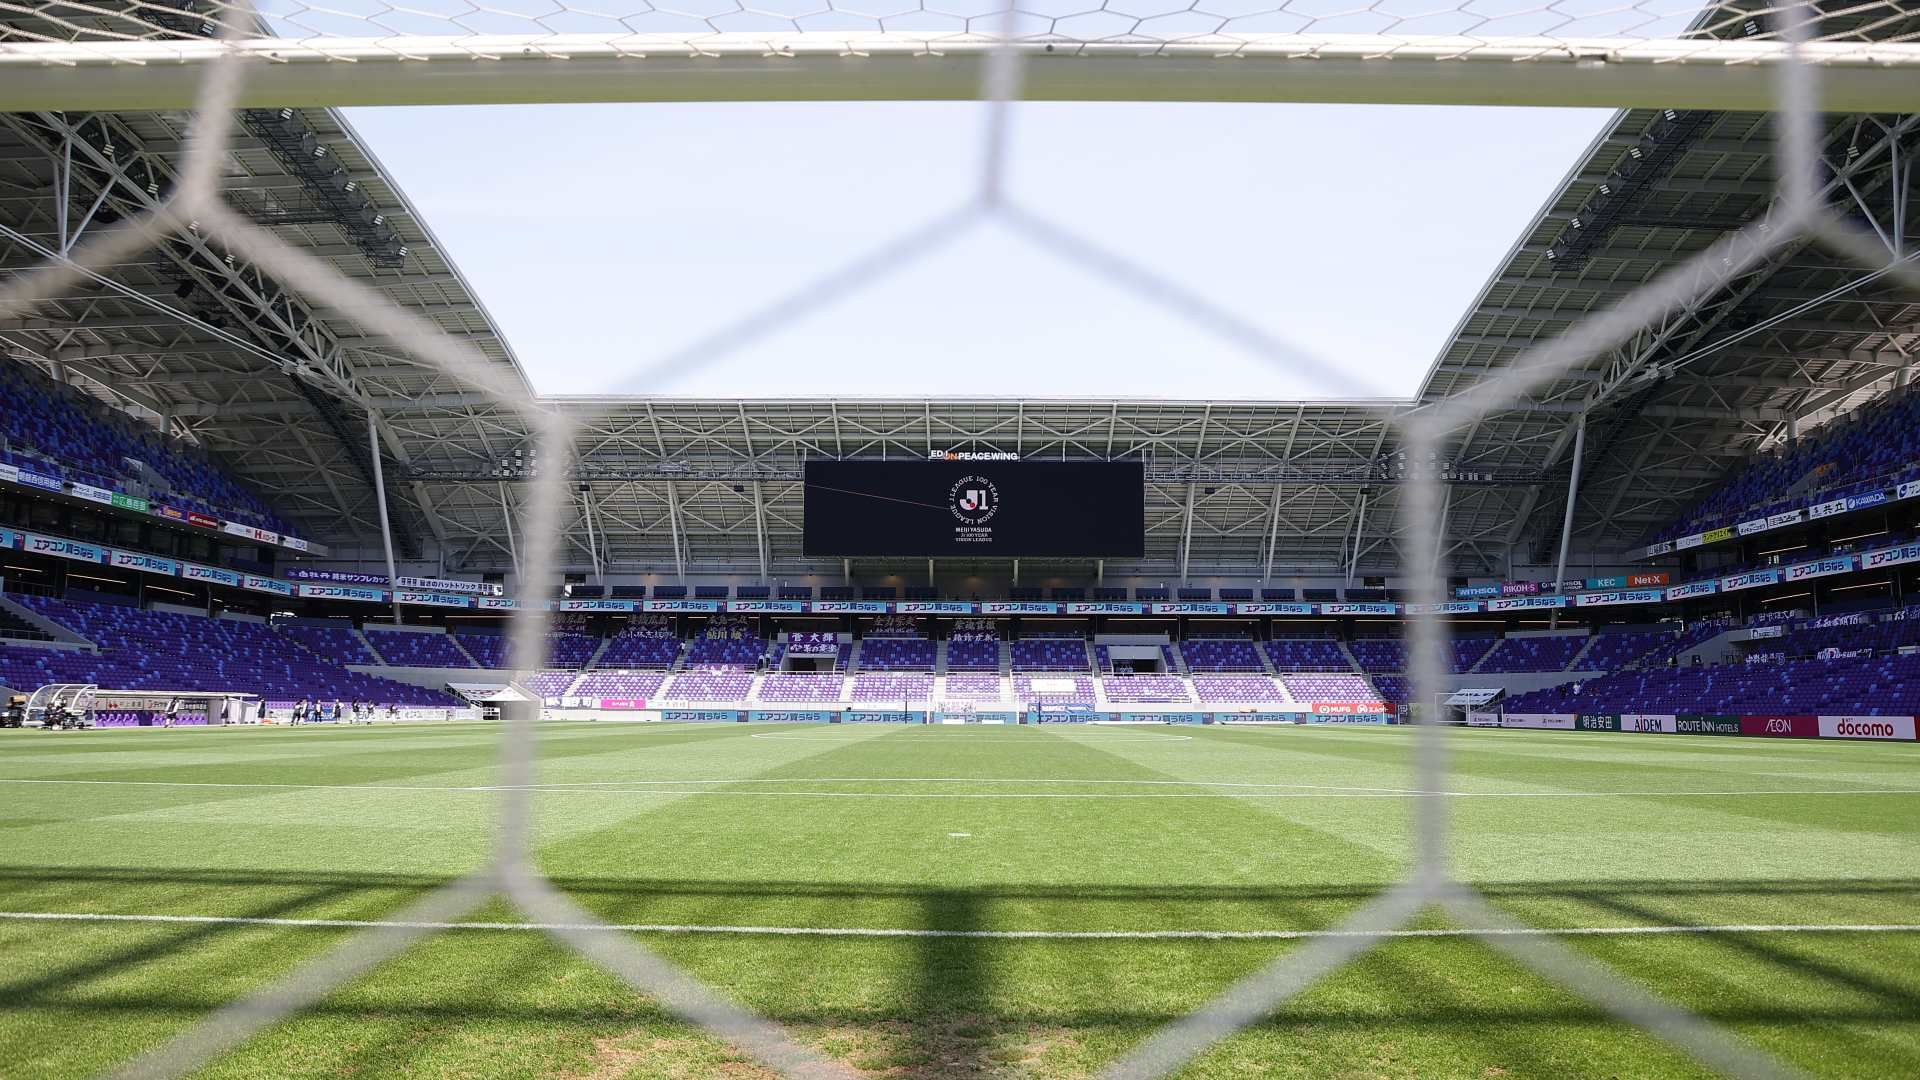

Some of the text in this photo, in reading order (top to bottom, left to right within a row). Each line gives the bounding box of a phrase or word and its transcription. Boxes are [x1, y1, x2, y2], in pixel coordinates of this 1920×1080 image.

[958, 452, 1018, 460] PEACEWING
[988, 481, 999, 502] YEAR
[1855, 492, 1885, 505] KAWADA
[1823, 502, 1845, 515] 共立
[1598, 579, 1615, 587] KEC
[1460, 587, 1499, 596] WITHSOL
[1582, 715, 1613, 729] 明治安田
[1678, 720, 1700, 731] ROUTE
[1715, 724, 1739, 733] HOTELS
[1837, 718, 1894, 737] docomo
